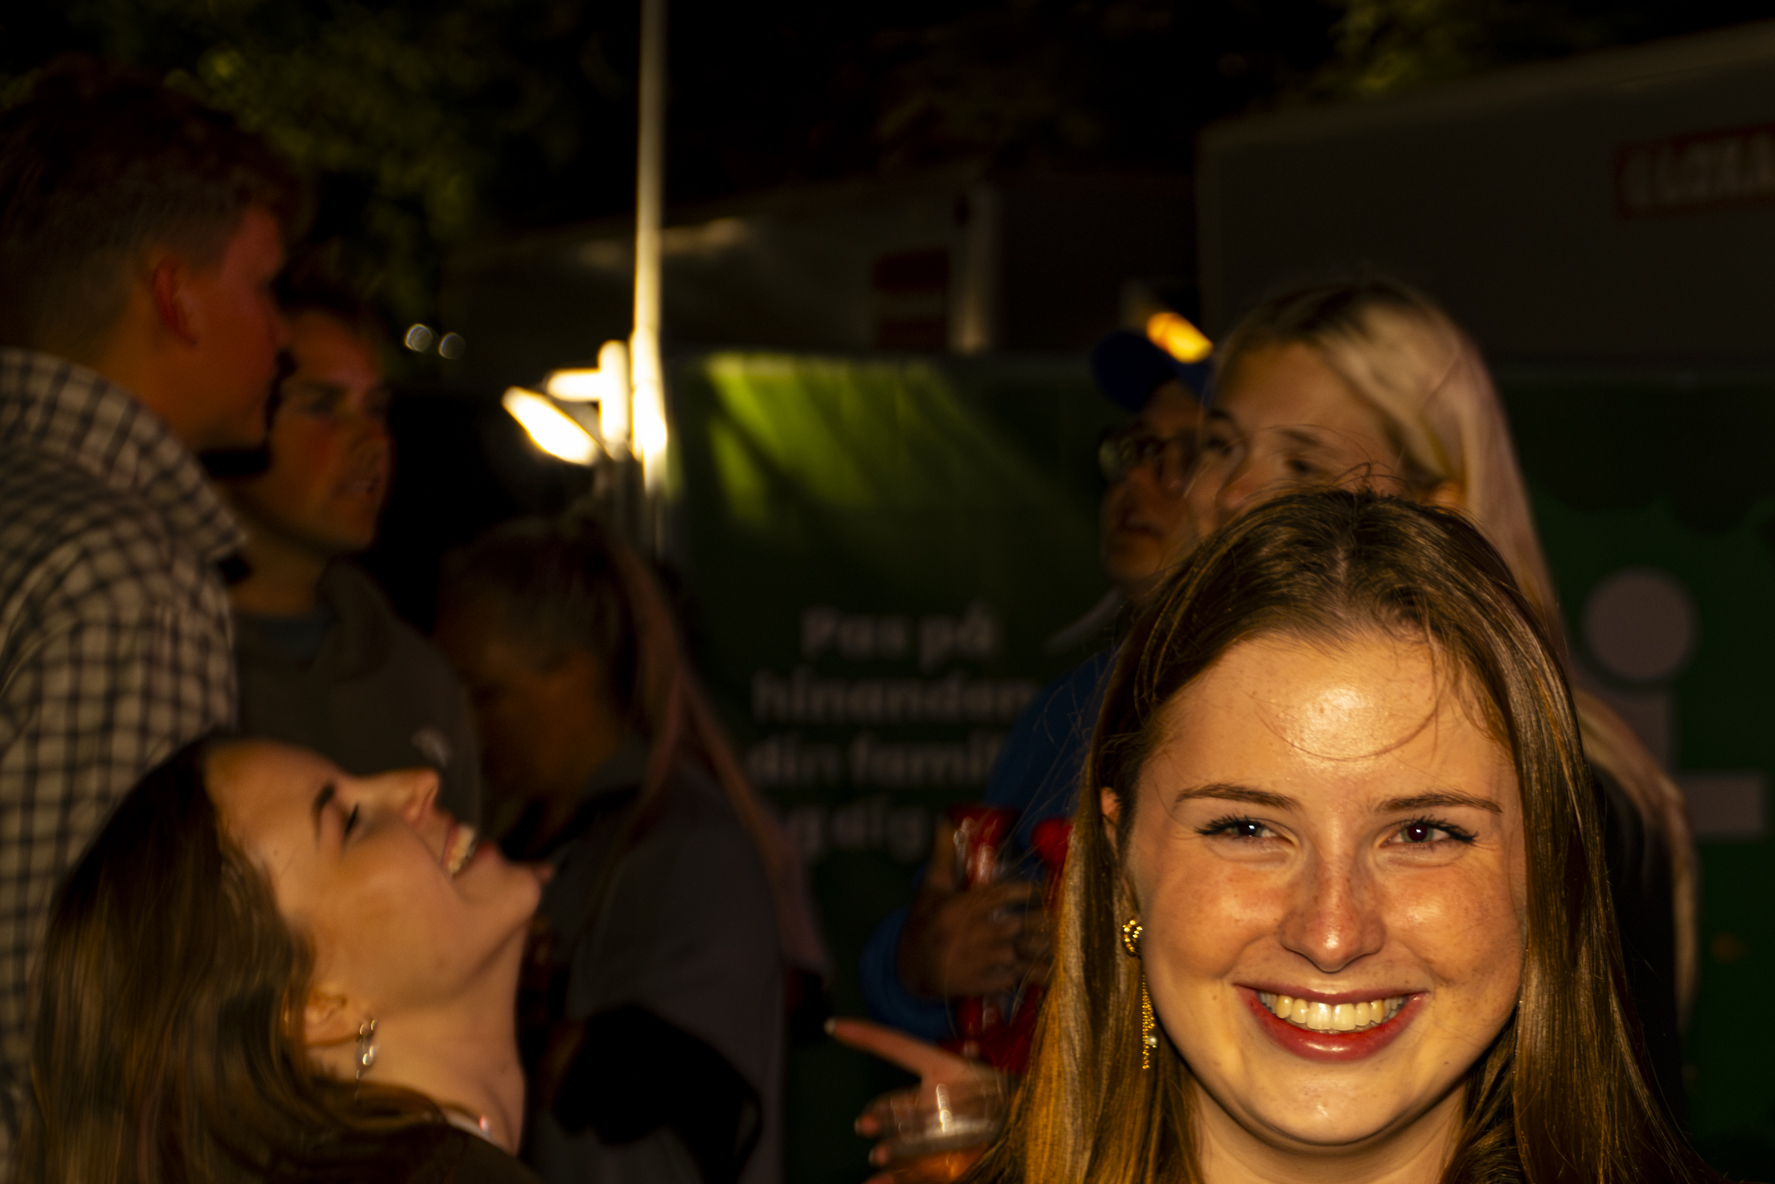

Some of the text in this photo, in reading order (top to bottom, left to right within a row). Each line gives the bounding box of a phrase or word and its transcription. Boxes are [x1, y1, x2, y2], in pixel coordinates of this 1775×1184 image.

[801, 602, 998, 672] Pas på
[746, 732, 843, 789] din
